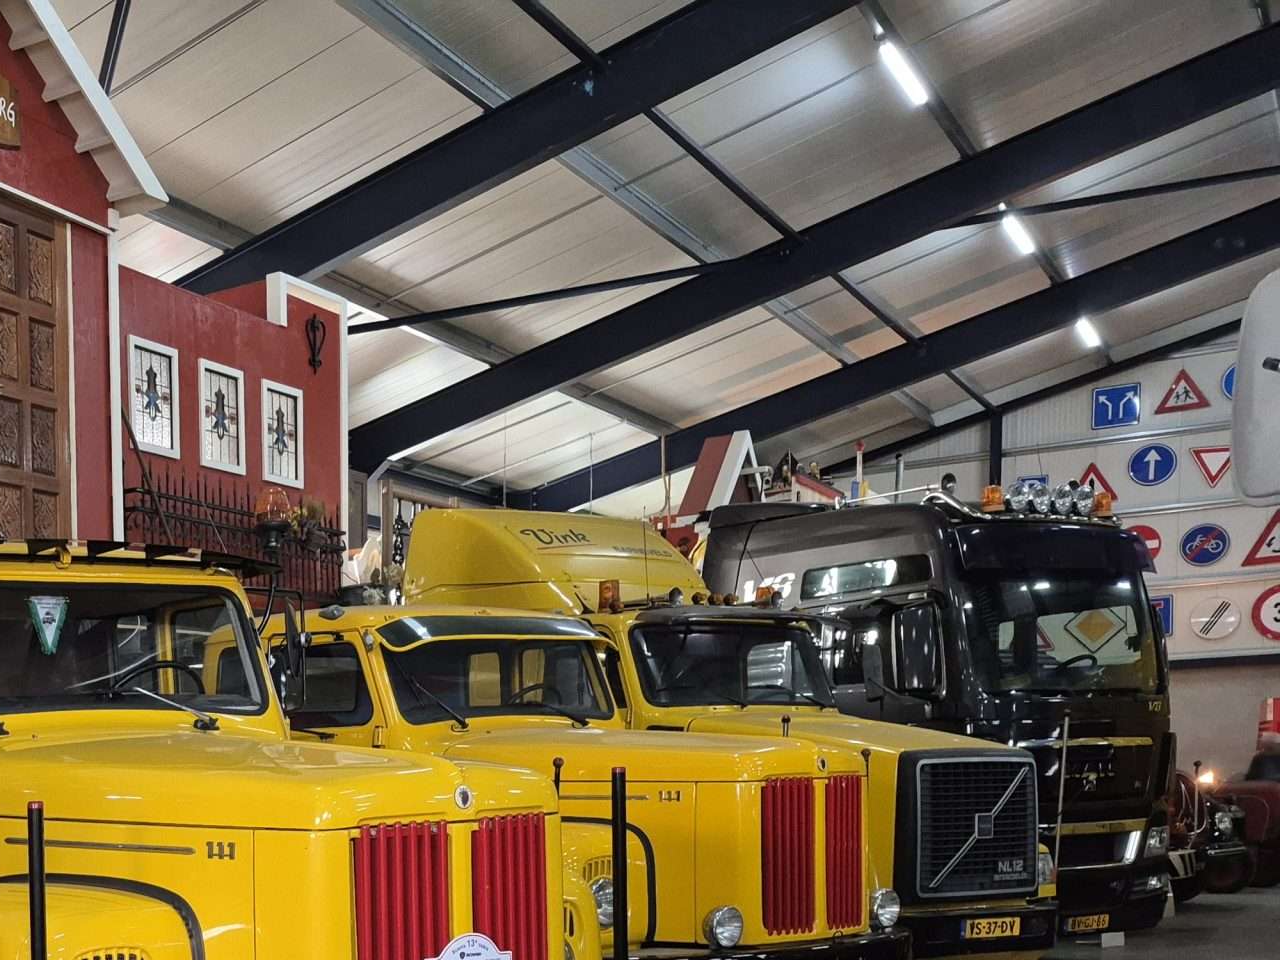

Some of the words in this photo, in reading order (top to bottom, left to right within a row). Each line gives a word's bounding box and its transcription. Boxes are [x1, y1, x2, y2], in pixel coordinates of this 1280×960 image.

[520, 528, 591, 545] Vink
[206, 841, 236, 860] 111
[998, 860, 1024, 873] NL12
